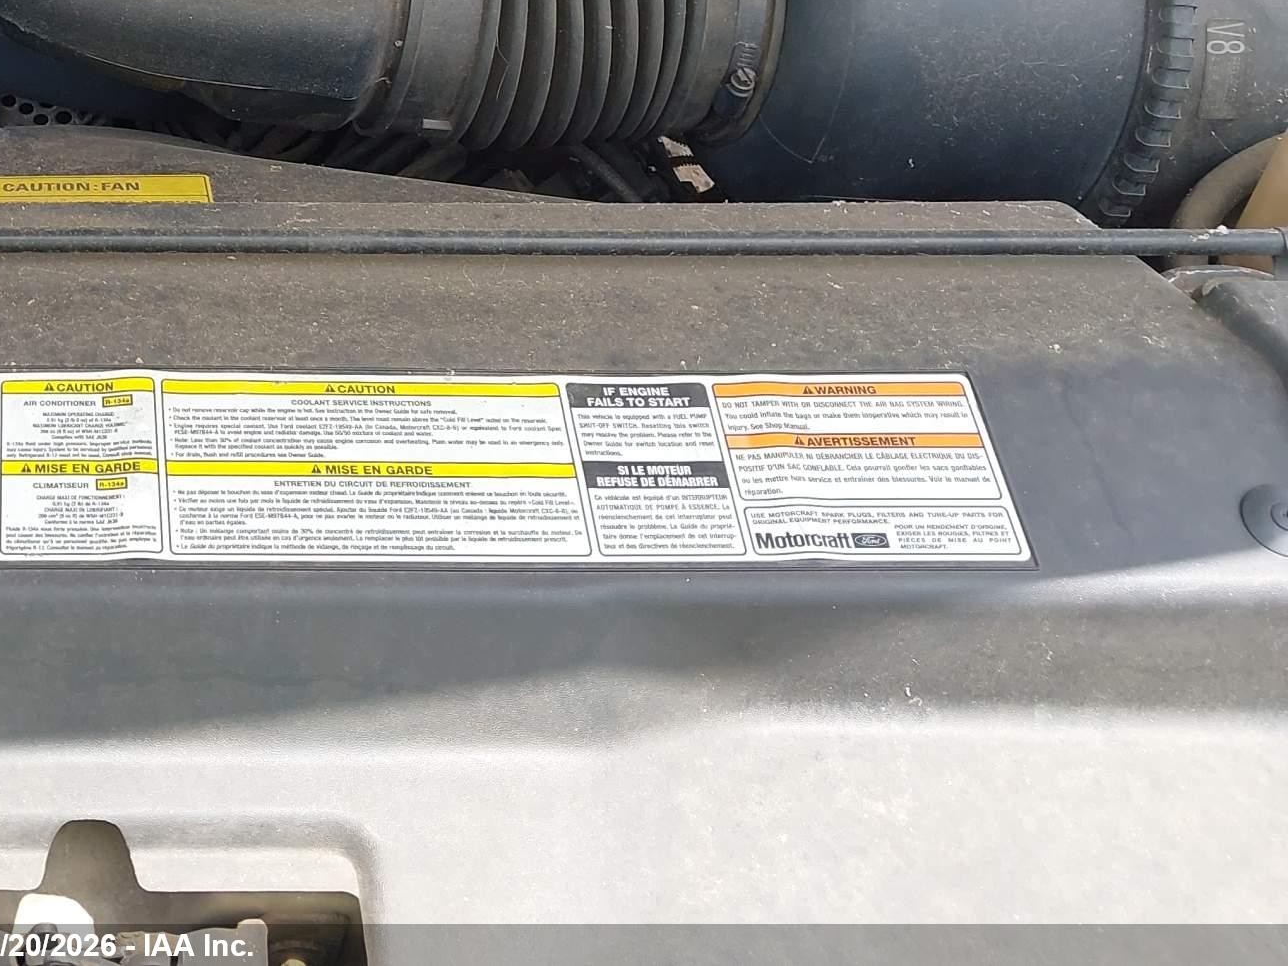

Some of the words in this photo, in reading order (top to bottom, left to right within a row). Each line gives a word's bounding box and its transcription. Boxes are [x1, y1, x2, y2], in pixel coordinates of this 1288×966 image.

[1206, 22, 1246, 54] V8
[102, 182, 140, 191] FAN
[57, 383, 114, 392] CAUTION
[337, 384, 395, 394] CAUTION
[603, 387, 616, 396] IF
[620, 387, 670, 396] ENGINE
[815, 386, 877, 395] WARNING
[587, 398, 624, 406] FAILS
[626, 398, 644, 406] TO
[648, 397, 690, 406] START
[808, 436, 916, 447] AVERTISSEMENT
[35, 464, 68, 473] MISE
[72, 464, 90, 472] EN
[95, 462, 141, 472] GARDE
[326, 465, 358, 474] MISE
[363, 466, 382, 475] EN
[386, 466, 433, 475] GARDE
[618, 466, 628, 475] SI
[632, 466, 645, 475] LE
[647, 465, 691, 475] MOTEUR
[596, 477, 638, 486] REFUSE
[641, 477, 654, 486] DE
[659, 474, 718, 486] DÉMARRER
[755, 532, 852, 550] Motorcraft
[862, 536, 881, 545] Ford
